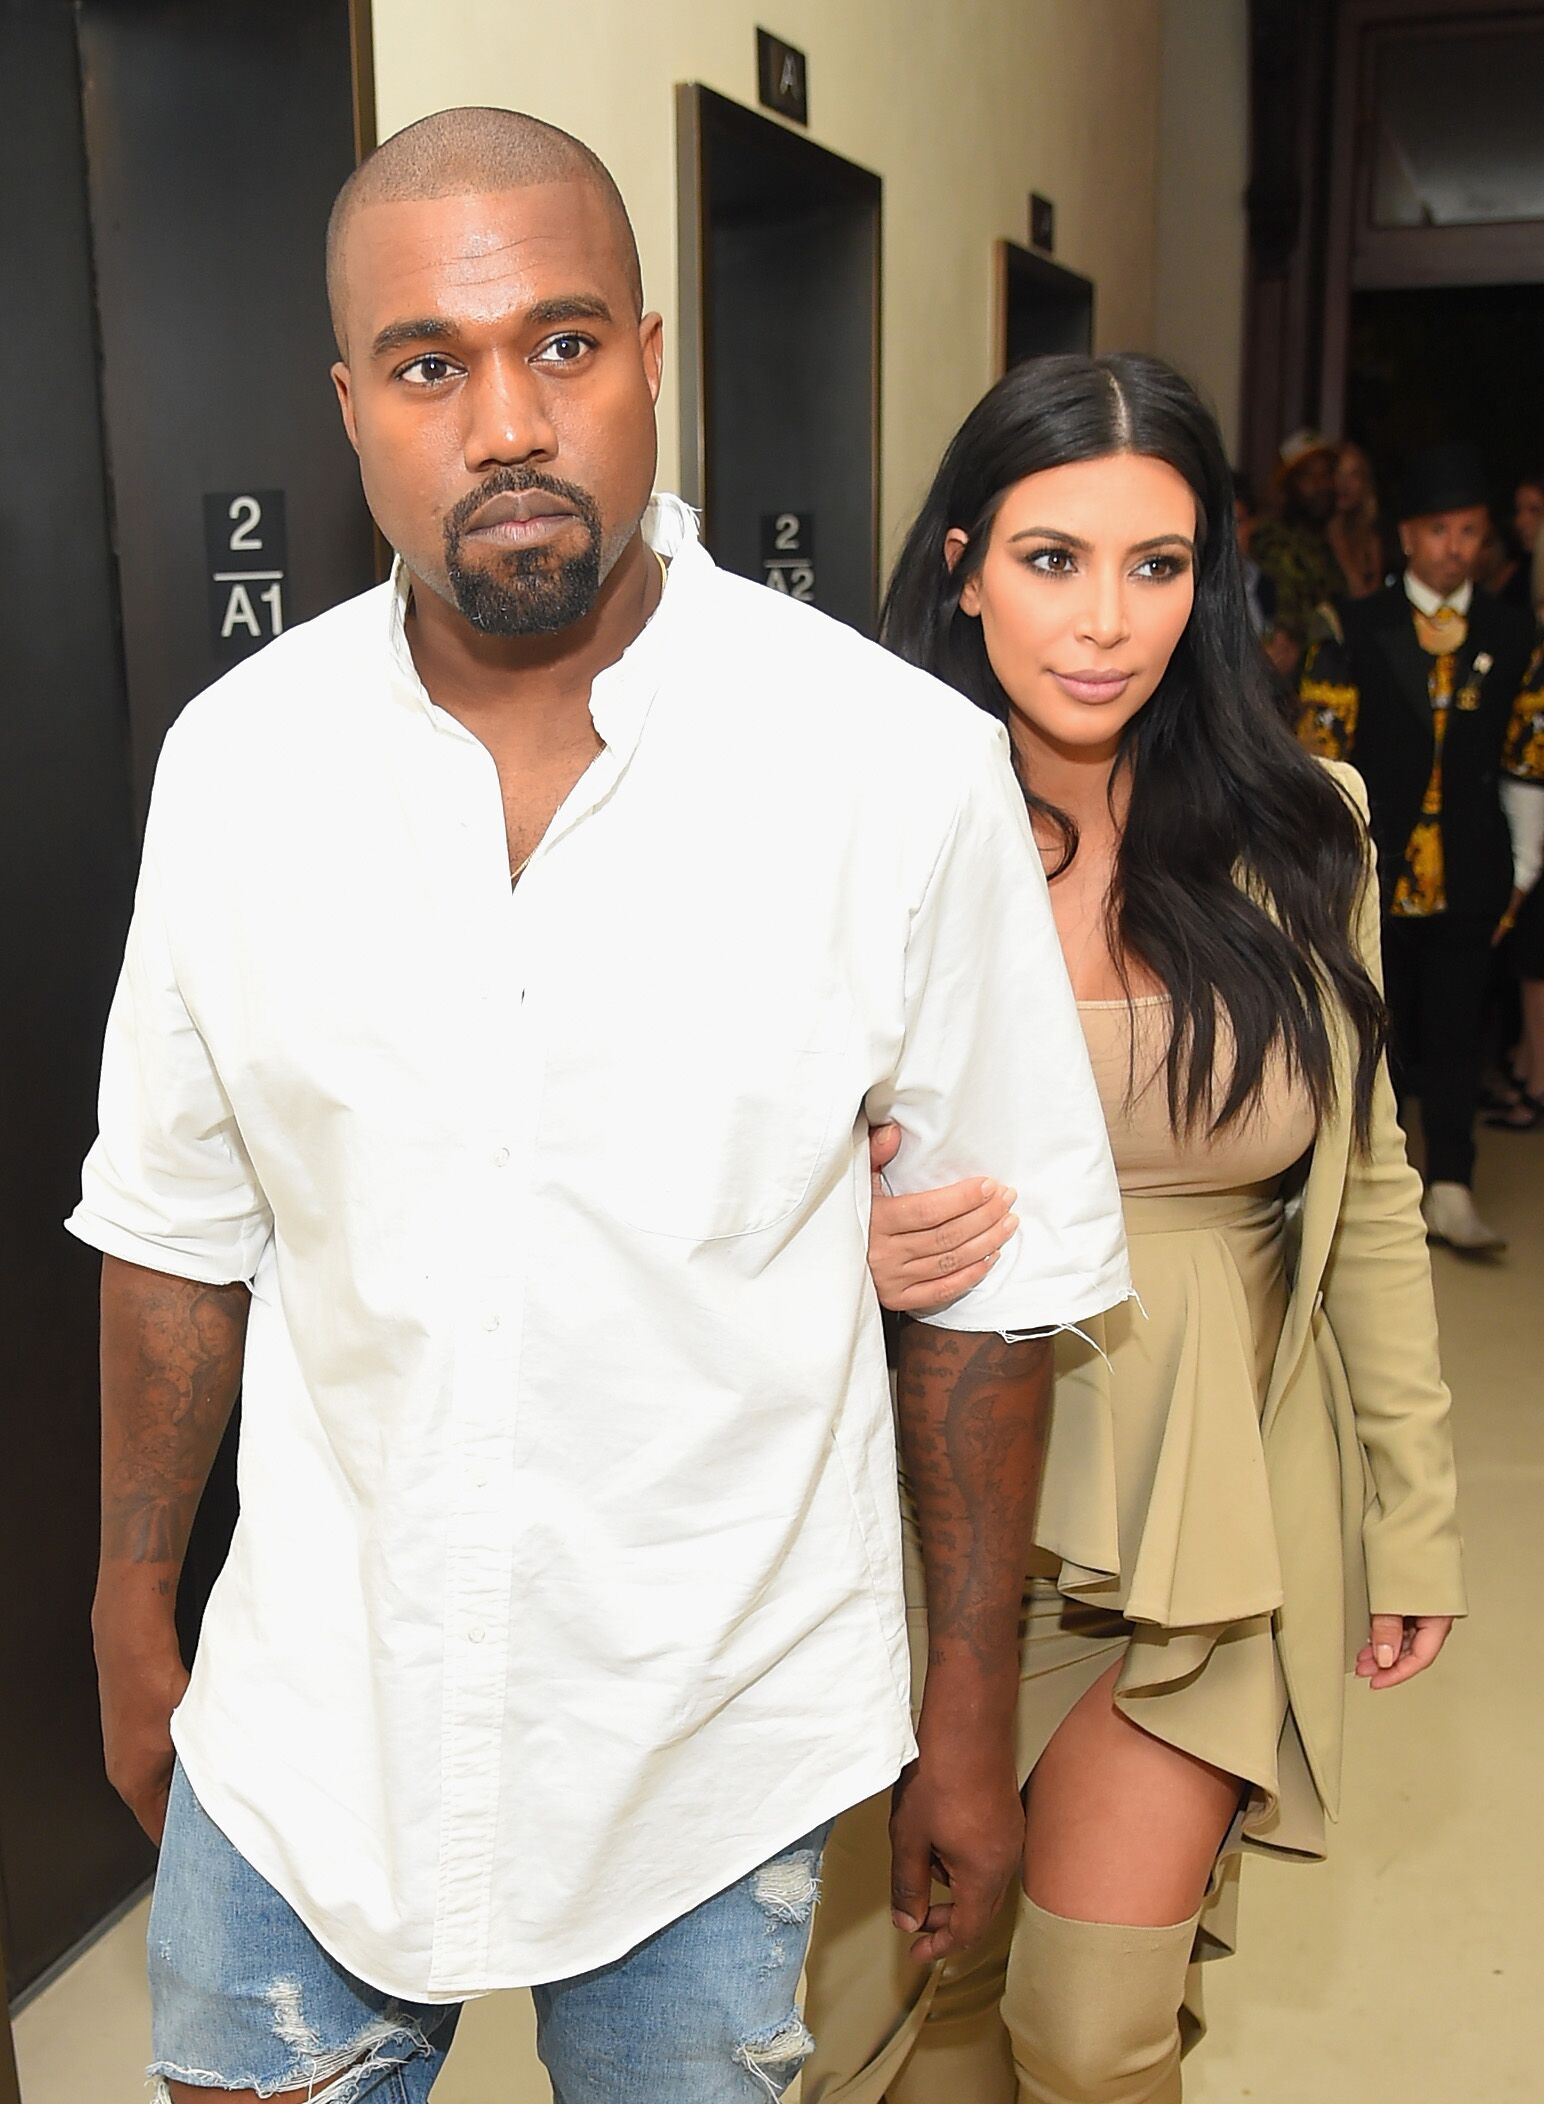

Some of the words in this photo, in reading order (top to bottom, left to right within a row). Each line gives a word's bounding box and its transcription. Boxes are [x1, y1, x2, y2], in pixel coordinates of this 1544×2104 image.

[779, 53, 802, 101] A
[229, 495, 262, 550] 2
[775, 513, 800, 550] 2
[221, 582, 283, 637] A1
